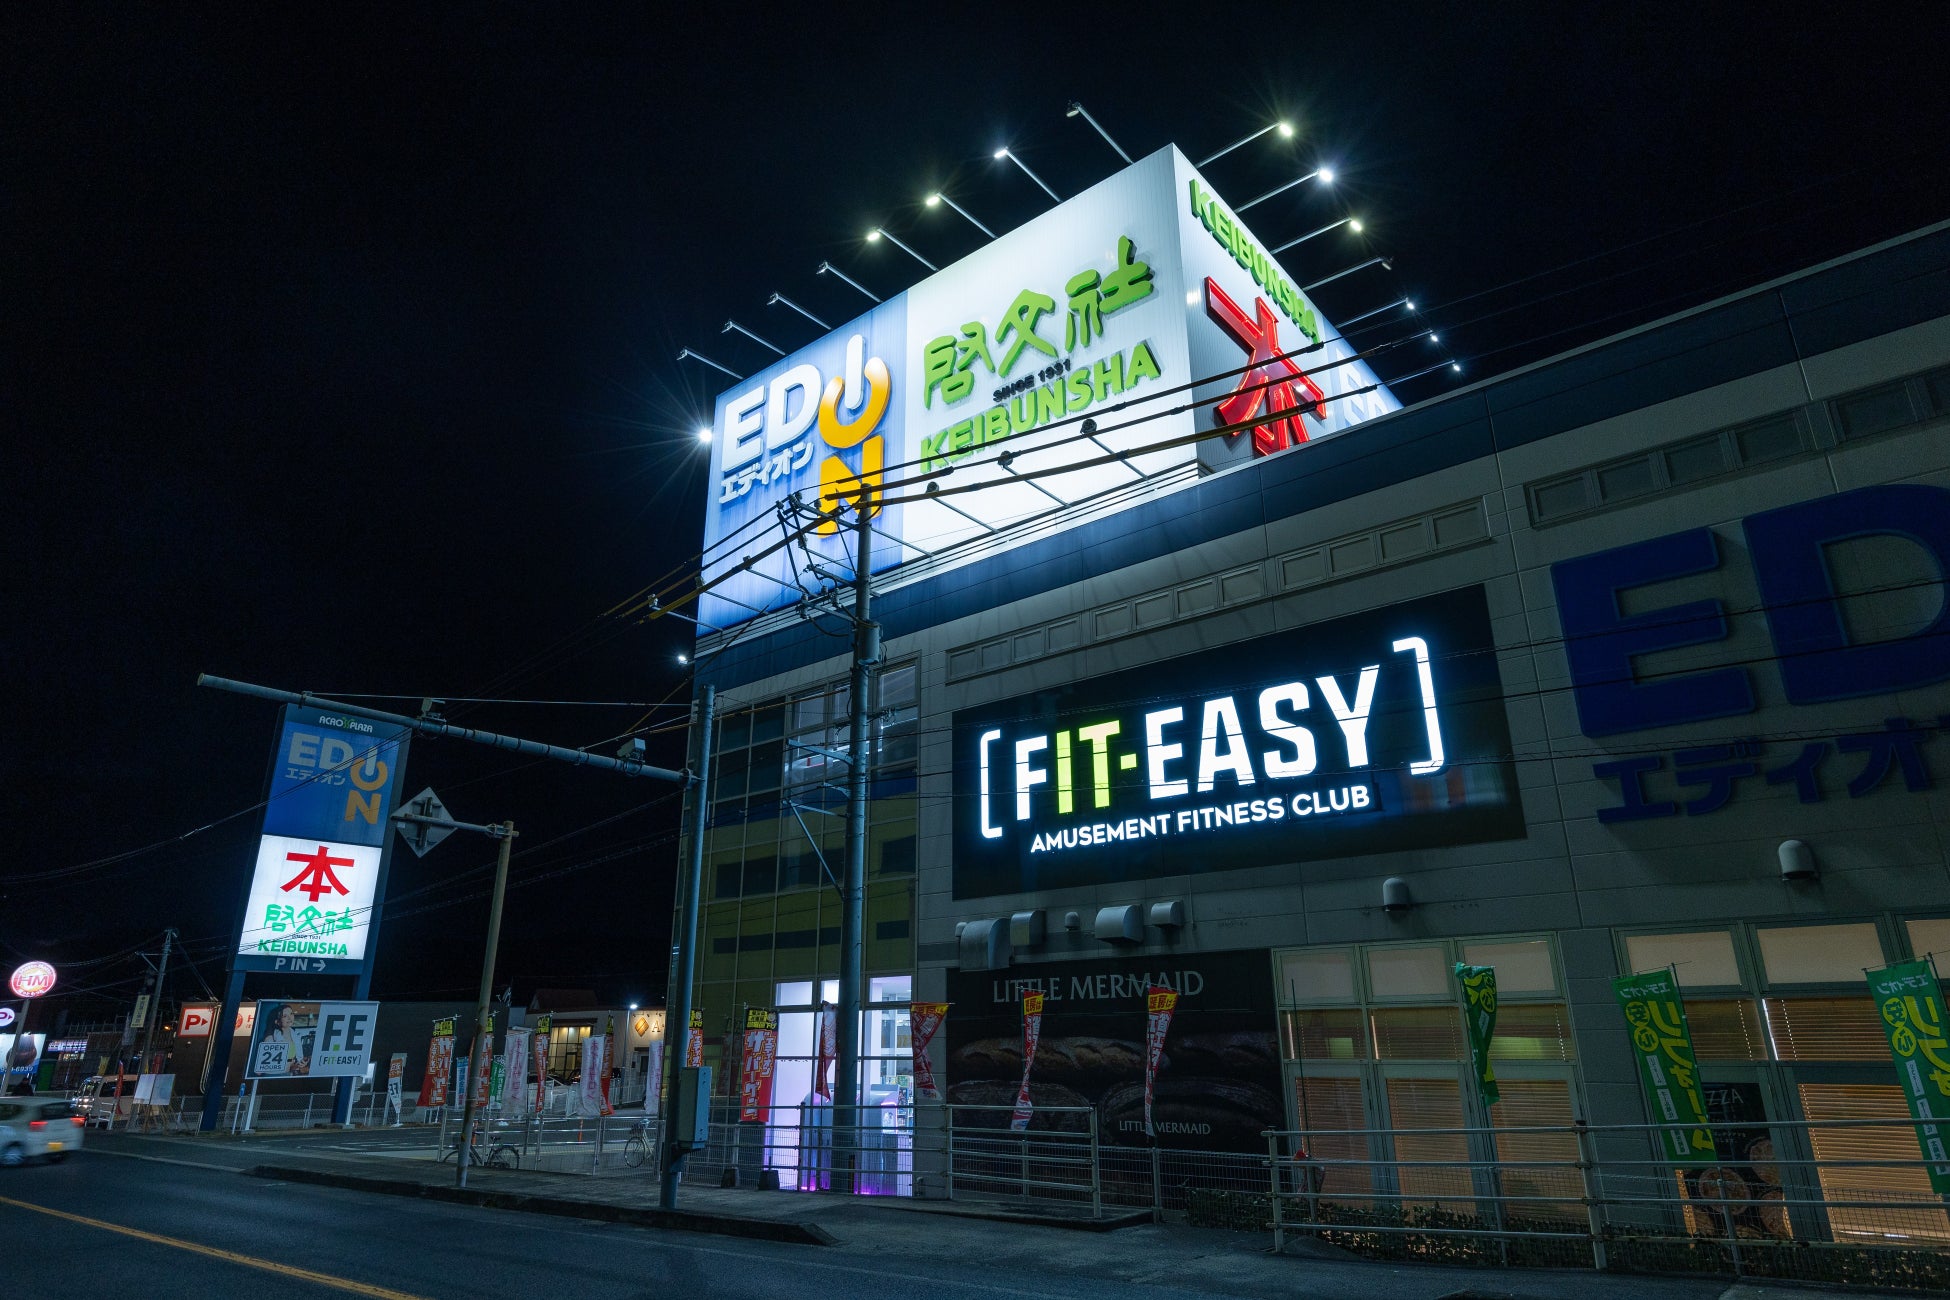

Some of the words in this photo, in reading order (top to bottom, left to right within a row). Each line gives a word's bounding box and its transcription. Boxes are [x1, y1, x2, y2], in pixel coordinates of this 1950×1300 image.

[1189, 179, 1324, 348] KEIBUNSHA
[924, 235, 1154, 410] 啓文社
[993, 375, 1035, 402] SINCE
[1038, 358, 1071, 383] 1931
[1204, 276, 1327, 457] 本
[920, 341, 1162, 475] KEIBUNSHA
[721, 334, 891, 538] EDION
[719, 442, 814, 504] エディオン
[350, 722, 373, 733] PLAZA
[285, 767, 346, 786] エディオン
[287, 732, 388, 825] EDION
[1593, 715, 1950, 824] エディオ
[1030, 813, 1171, 854] AMUSEMENT
[1178, 798, 1285, 833] FITNESS
[1292, 785, 1370, 816] CLUB
[280, 845, 355, 902] 本
[264, 904, 353, 936] 啓文社
[258, 939, 348, 955] KEIBUNSHA
[274, 957, 286, 970] P
[290, 958, 309, 971] IN
[17, 975, 48, 987] HM
[1070, 970, 1204, 1000] MERMAID
[184, 1014, 201, 1031] P
[261, 1052, 283, 1065] 24
[1119, 1120, 1146, 1132] LITTL
[1156, 1121, 1211, 1135] MERMAID
